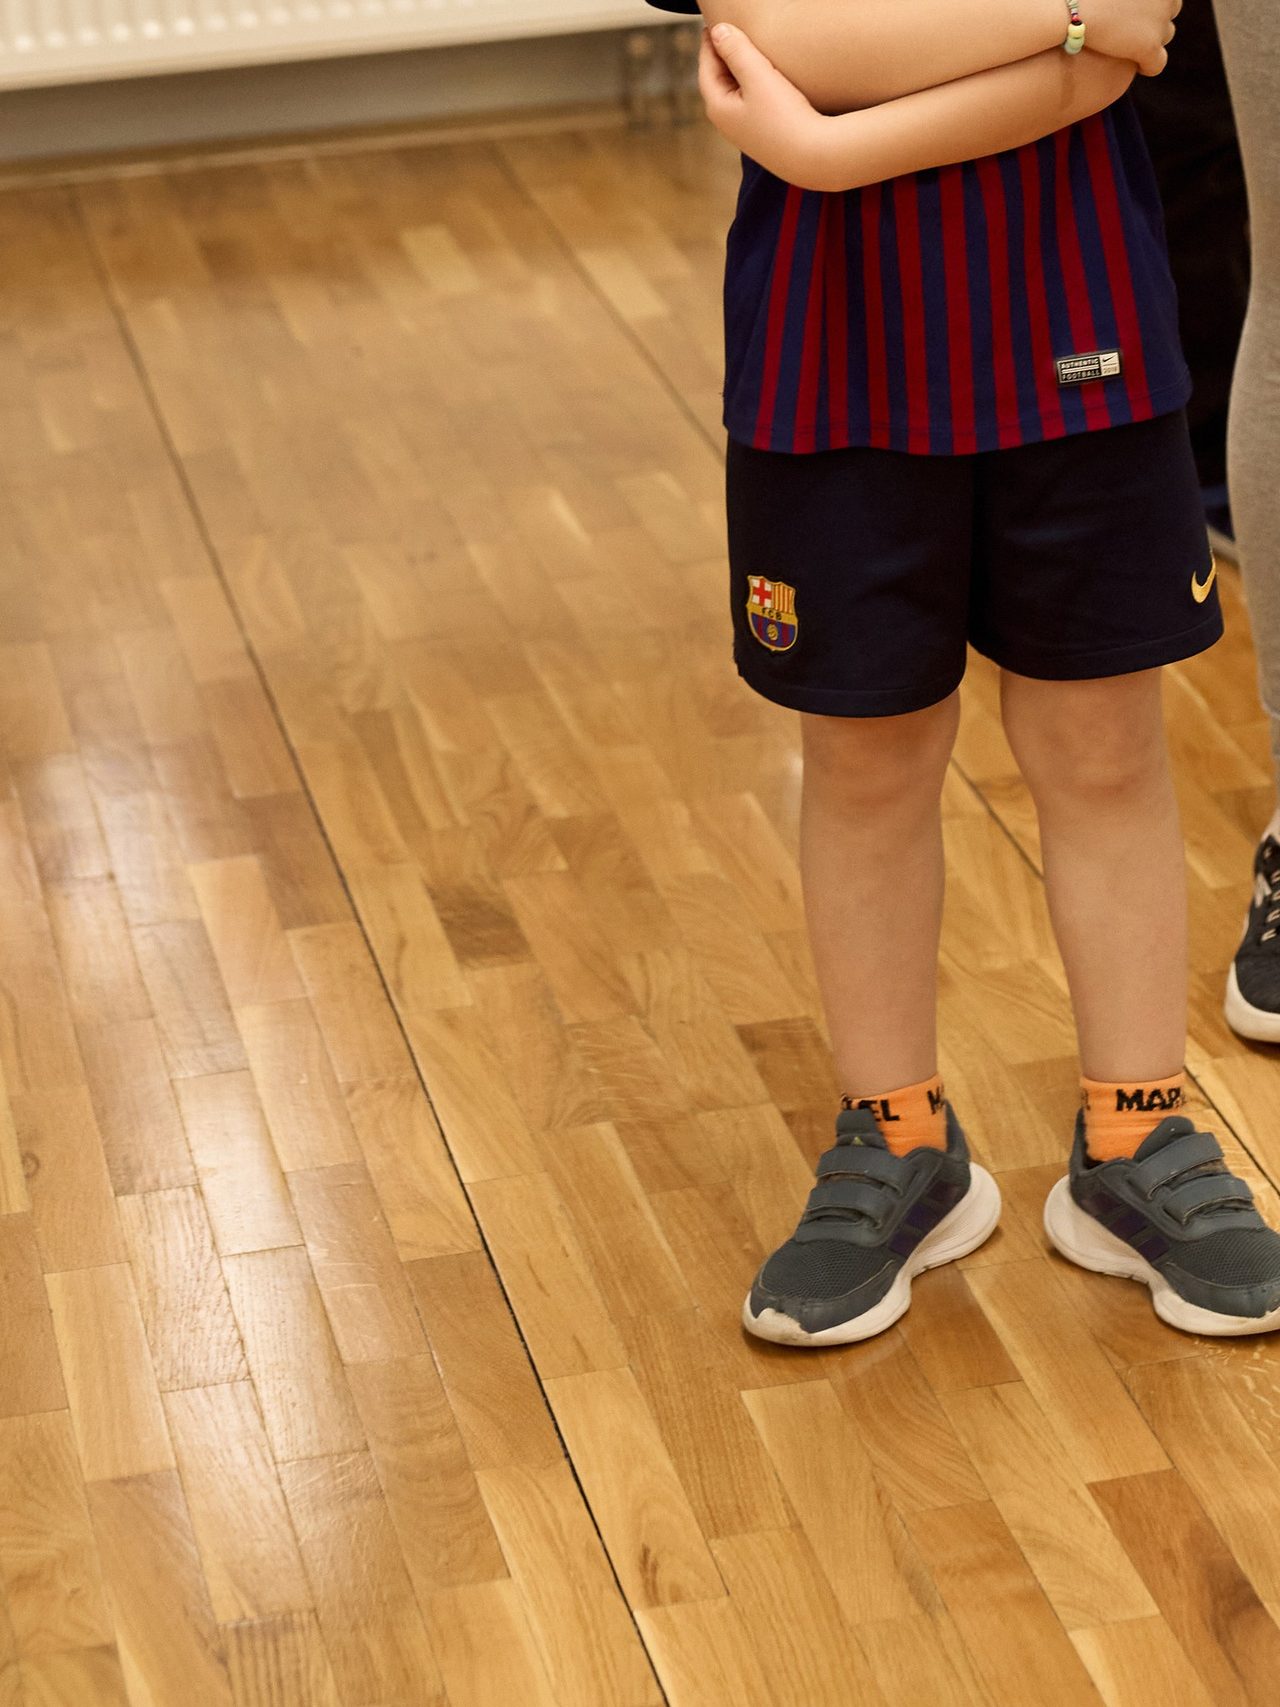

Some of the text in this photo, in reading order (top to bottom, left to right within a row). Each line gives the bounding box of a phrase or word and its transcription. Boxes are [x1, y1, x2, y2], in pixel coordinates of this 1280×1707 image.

[1061, 357, 1099, 369] AUTHENTIC
[1062, 369, 1100, 380] FOOTBALL
[761, 606, 782, 621] FCB
